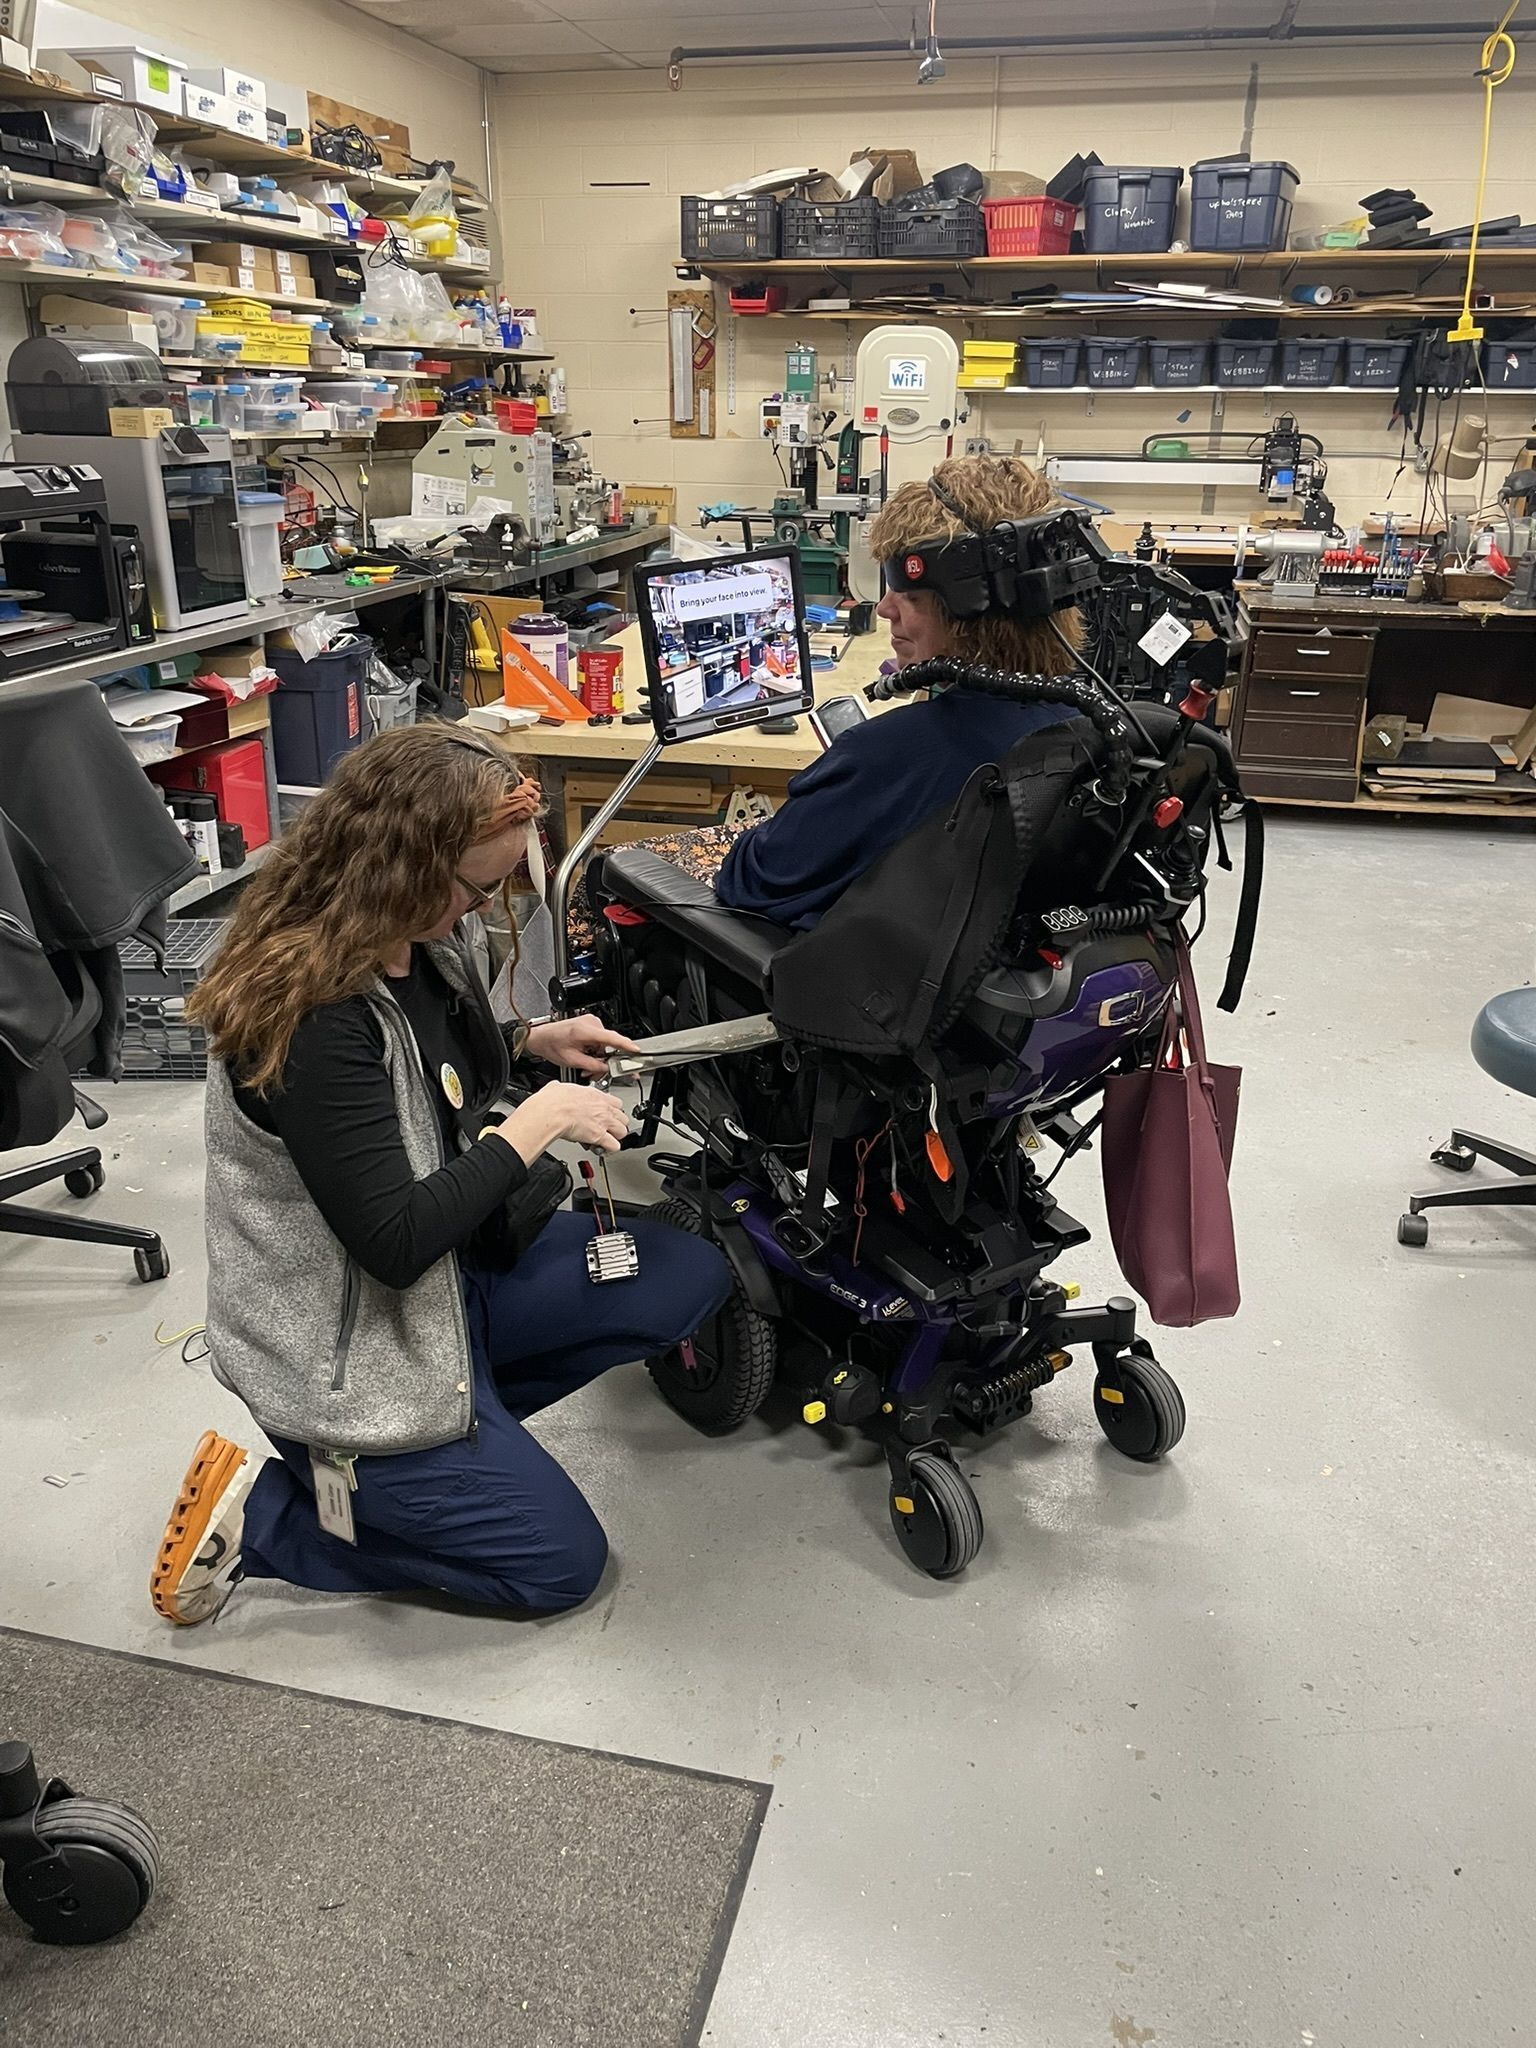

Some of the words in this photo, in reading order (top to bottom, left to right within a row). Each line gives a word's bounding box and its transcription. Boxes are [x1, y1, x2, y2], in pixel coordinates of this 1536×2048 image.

[891, 373, 923, 387] WiFi
[680, 598, 700, 608] Bring
[700, 596, 718, 606] your
[718, 593, 734, 602] face
[735, 590, 749, 599] into
[830, 1283, 860, 1305] EDGE
[858, 1298, 868, 1309] 3
